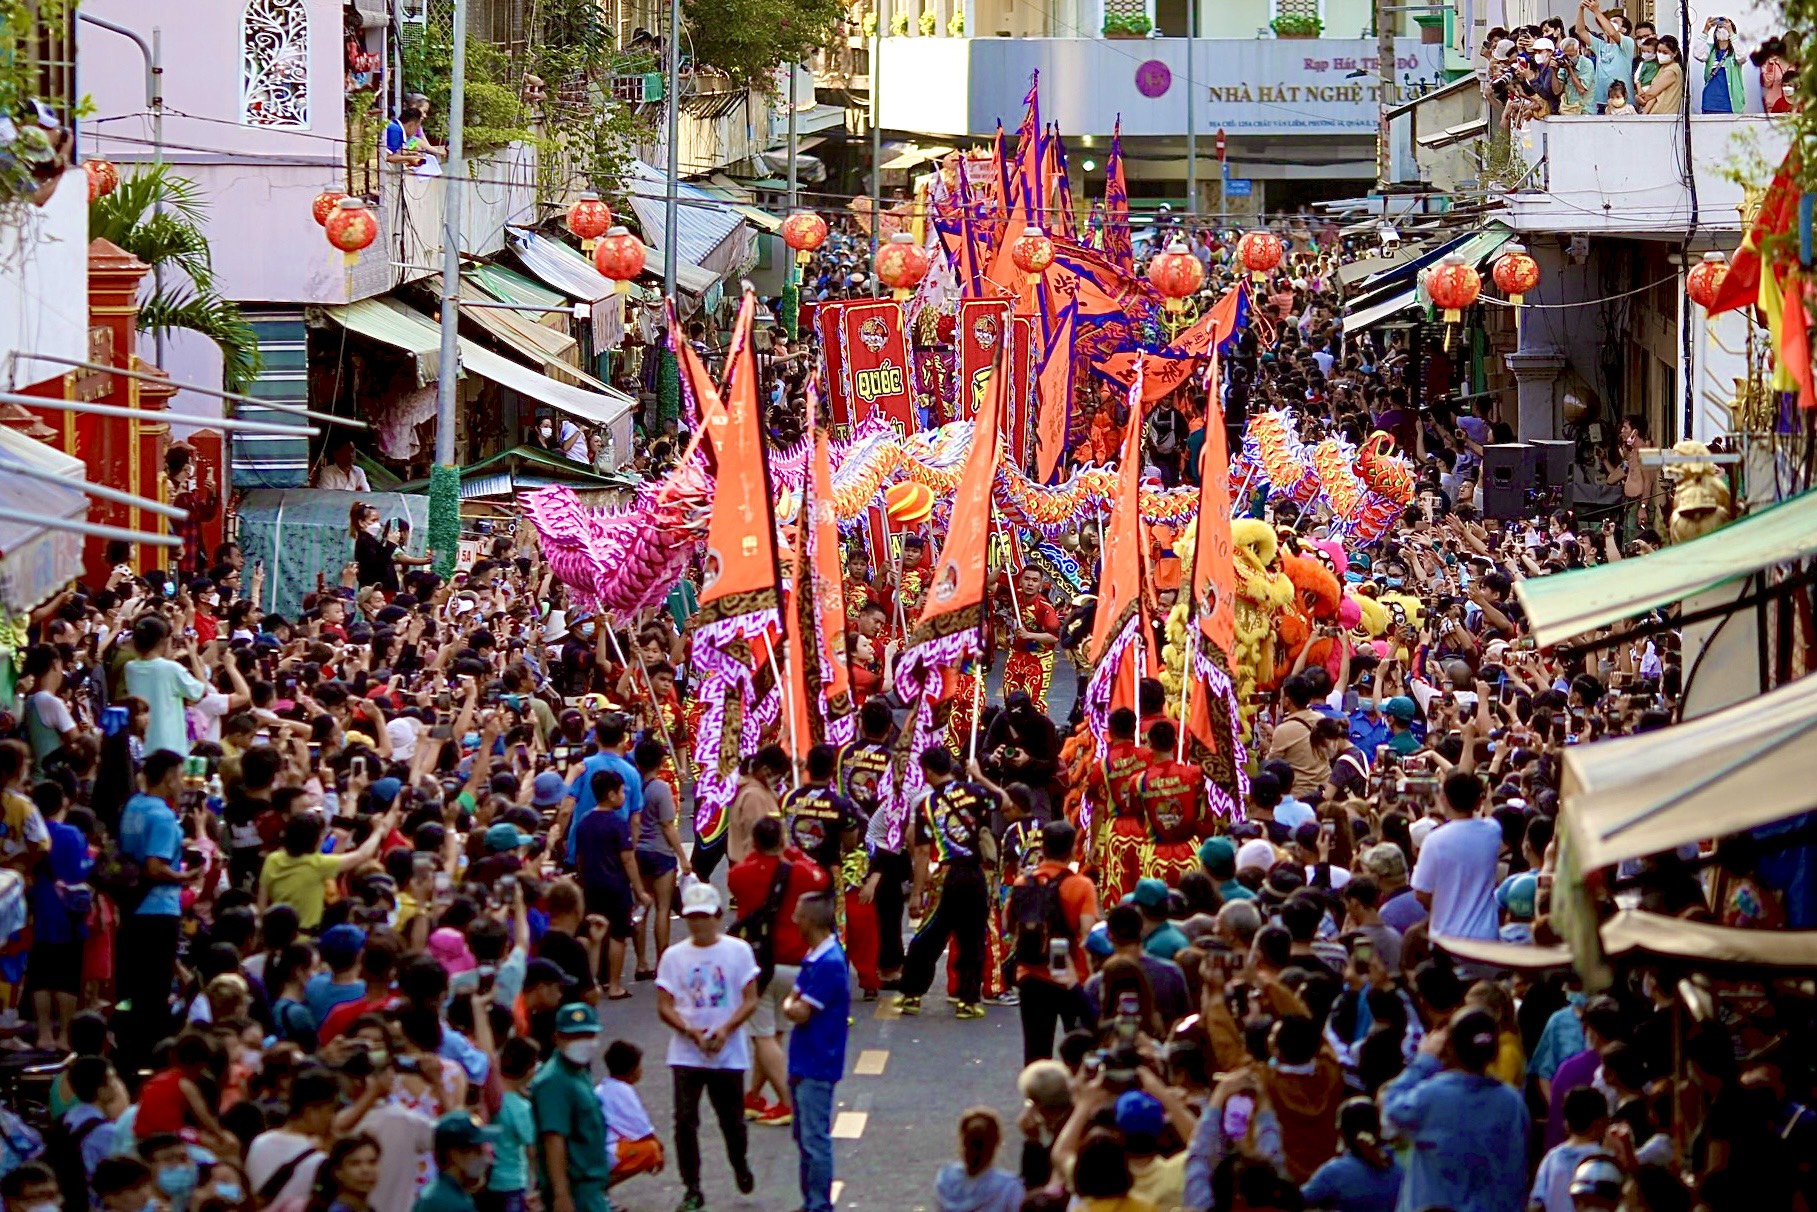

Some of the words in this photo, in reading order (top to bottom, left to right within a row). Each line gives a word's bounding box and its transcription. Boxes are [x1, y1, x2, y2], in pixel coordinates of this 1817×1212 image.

[1303, 58, 1329, 72] Rạp
[1333, 57, 1357, 70] Hát
[1397, 54, 1419, 70] ĐÔ
[1209, 81, 1252, 102] NHÀ
[1258, 81, 1300, 102] HÁT
[1305, 82, 1363, 105] NGHỆ
[857, 359, 903, 401] QUỐC
